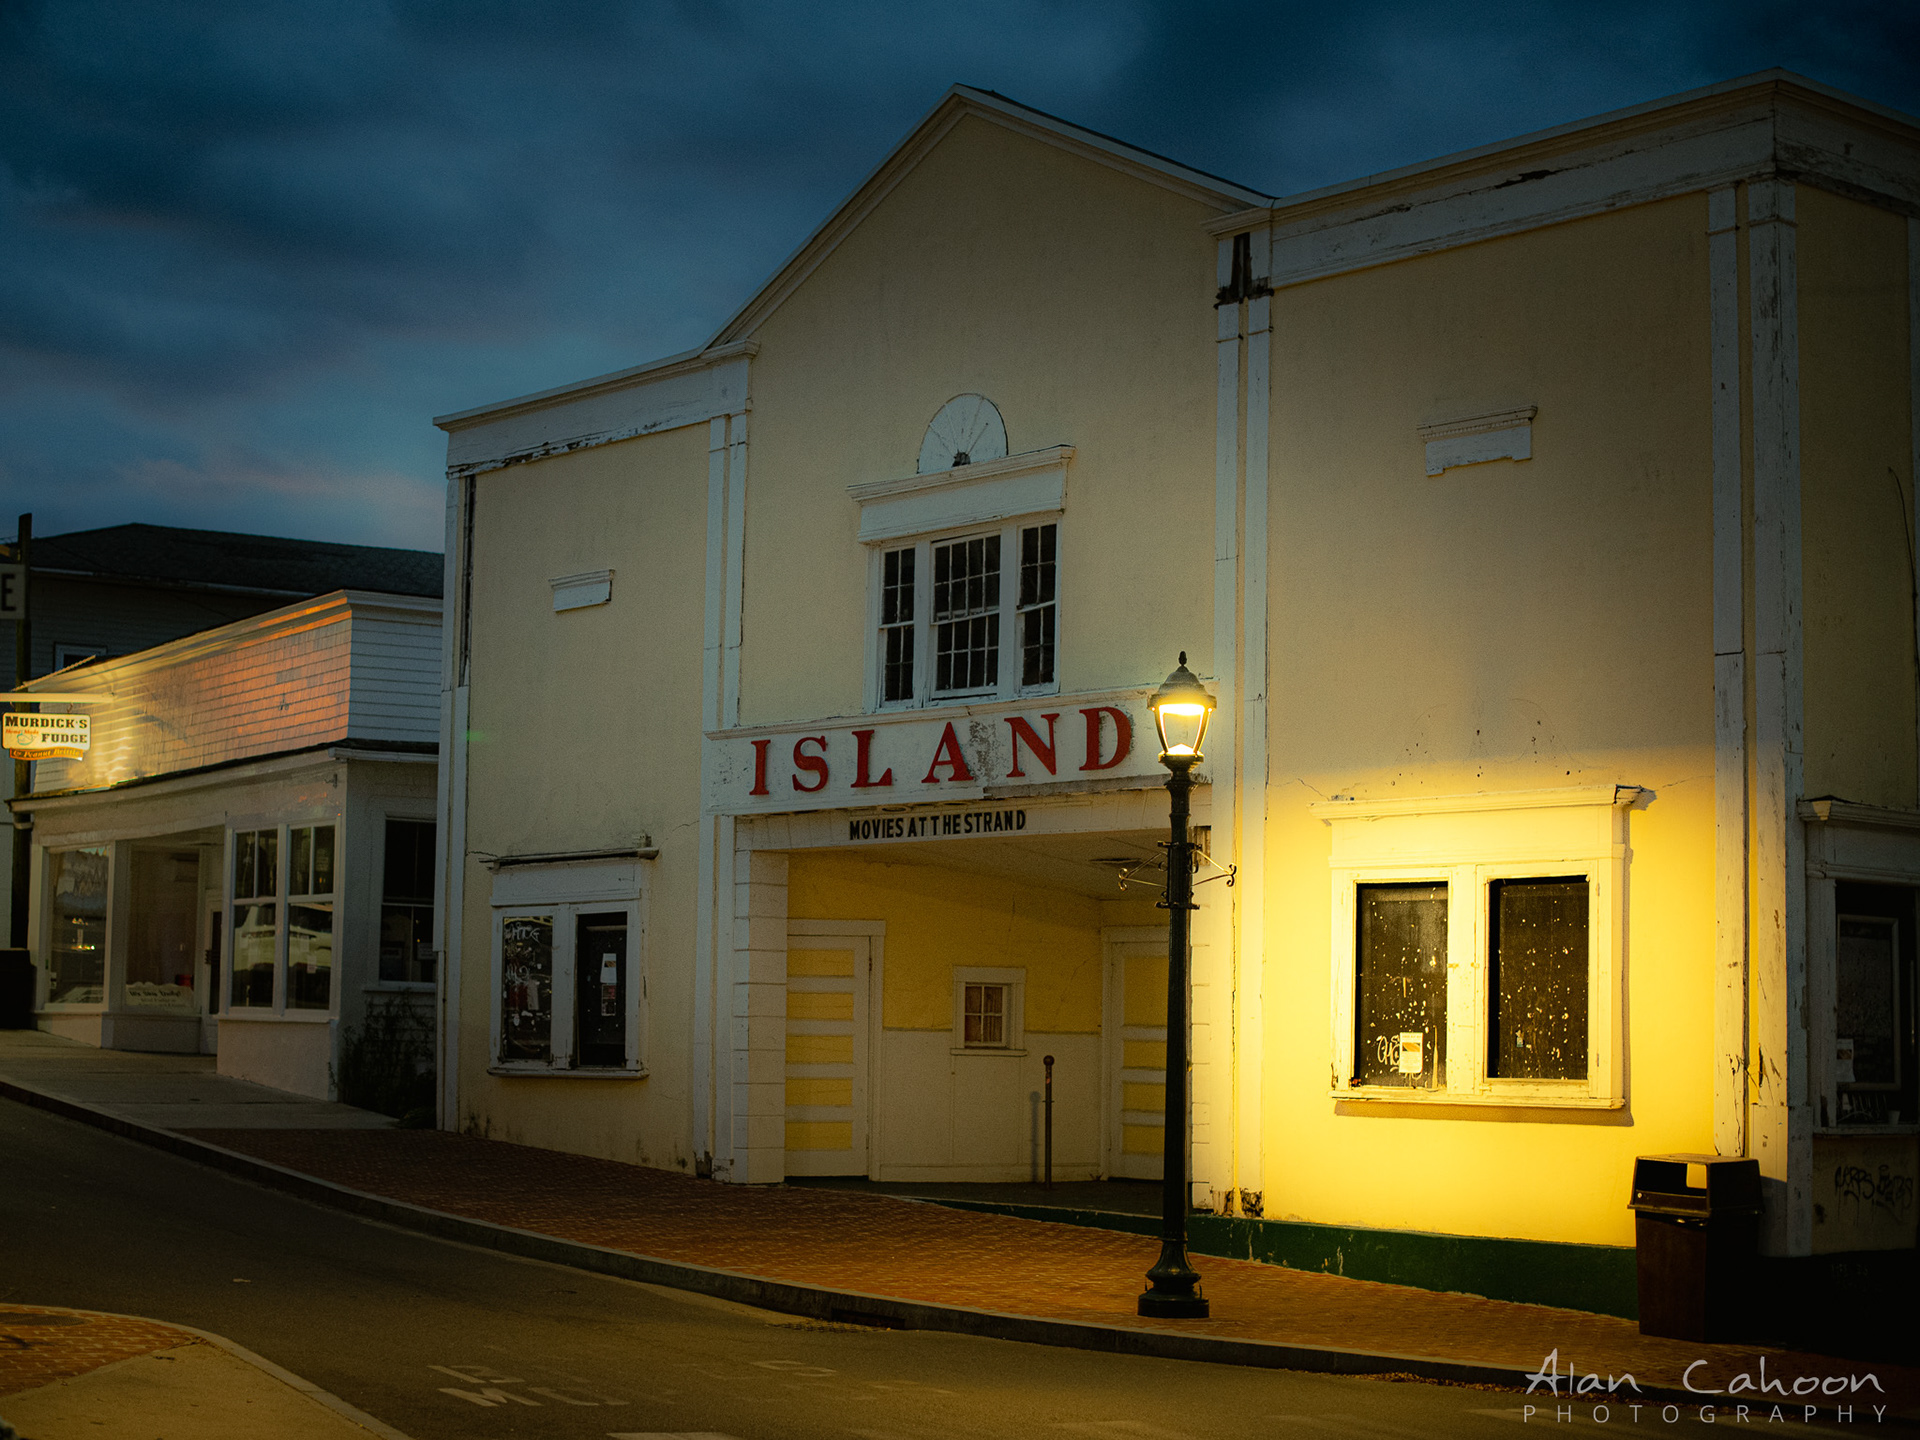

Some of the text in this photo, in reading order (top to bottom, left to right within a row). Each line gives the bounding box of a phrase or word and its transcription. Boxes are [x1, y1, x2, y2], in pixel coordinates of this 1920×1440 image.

[5, 716, 88, 730] MURDICK'S
[41, 733, 88, 743] FUDGE
[749, 706, 1134, 797] ISLAND
[849, 816, 904, 840] MOVIES
[964, 809, 1027, 833] STRAND
